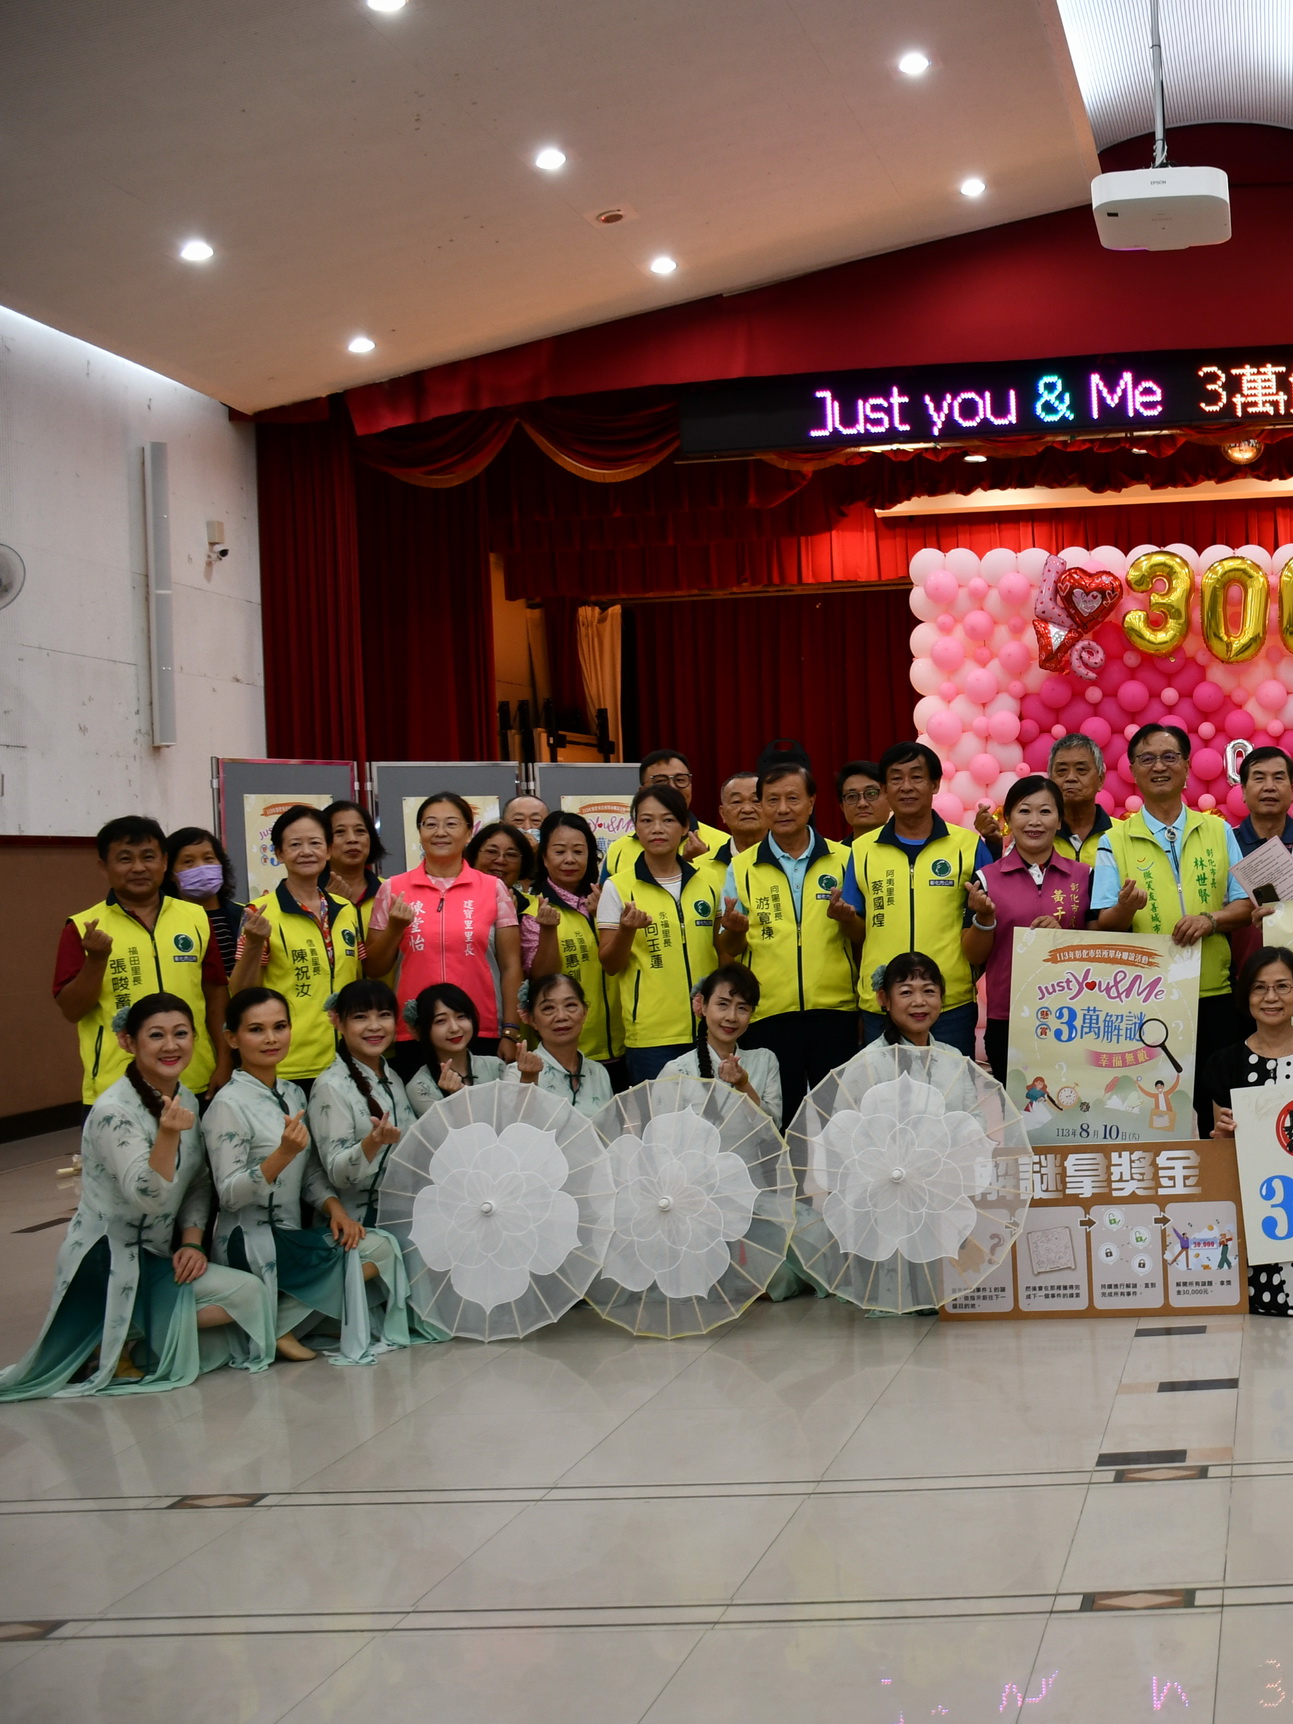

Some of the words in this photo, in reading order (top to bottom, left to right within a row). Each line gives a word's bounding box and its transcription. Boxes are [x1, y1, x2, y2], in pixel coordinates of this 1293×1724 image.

[810, 386, 911, 437] Just
[924, 389, 1017, 436] you
[1034, 374, 1075, 423] &
[1090, 371, 1163, 420] Me
[886, 869, 895, 906] 阿夷里長
[1193, 857, 1210, 904] 林世賢
[1206, 848, 1217, 889] 彰化市長
[872, 880, 885, 928] 蔡國煌
[659, 912, 672, 947] 永福里長
[128, 946, 142, 986] 福田里長
[292, 949, 311, 998] 陳祝汝
[1054, 1005, 1146, 1044] 3萬解謎
[1099, 1049, 1149, 1067] 幸福無敵
